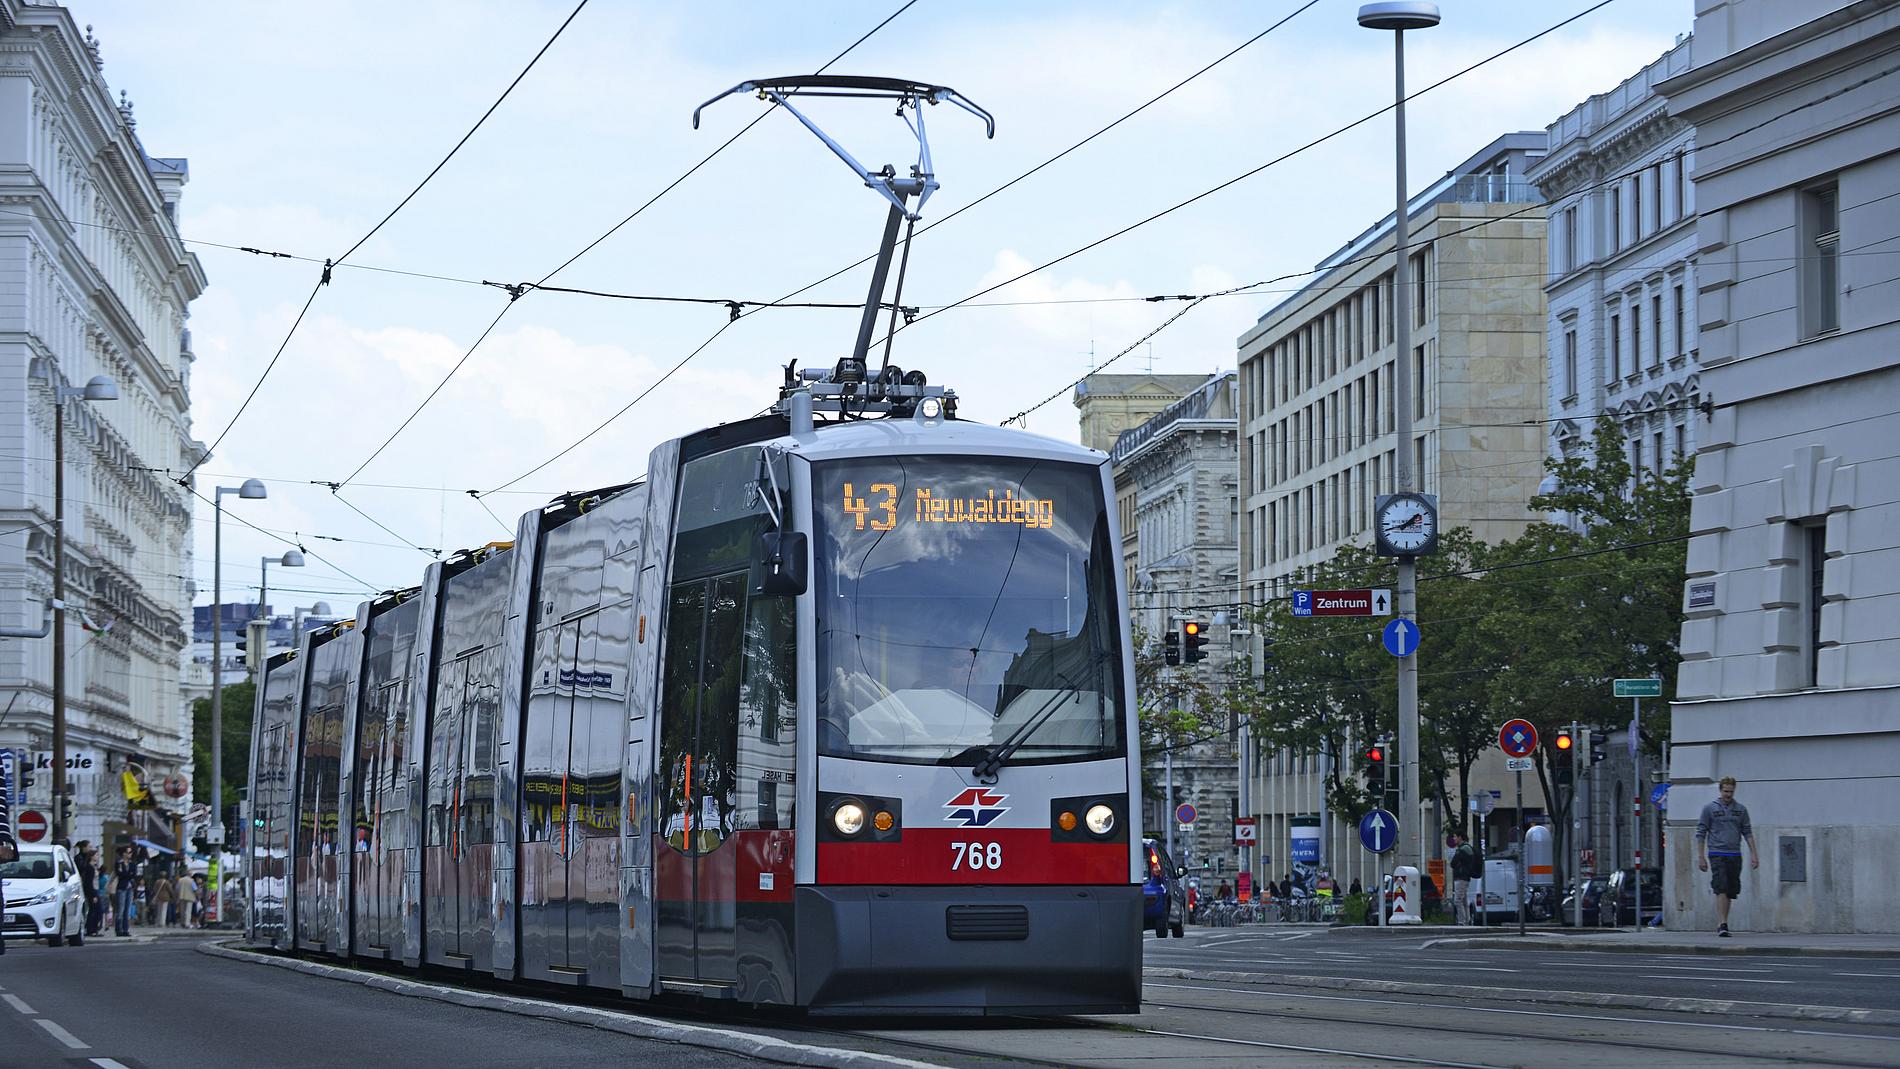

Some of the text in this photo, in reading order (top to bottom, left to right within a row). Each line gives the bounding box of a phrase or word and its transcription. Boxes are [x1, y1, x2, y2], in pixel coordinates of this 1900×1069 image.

[843, 483, 1053, 531] 43 Neuwaldegg
[1294, 607, 1312, 615] Wien
[1316, 598, 1367, 609] Zentrum
[37, 753, 92, 769] kpie
[951, 842, 1002, 871] 768
